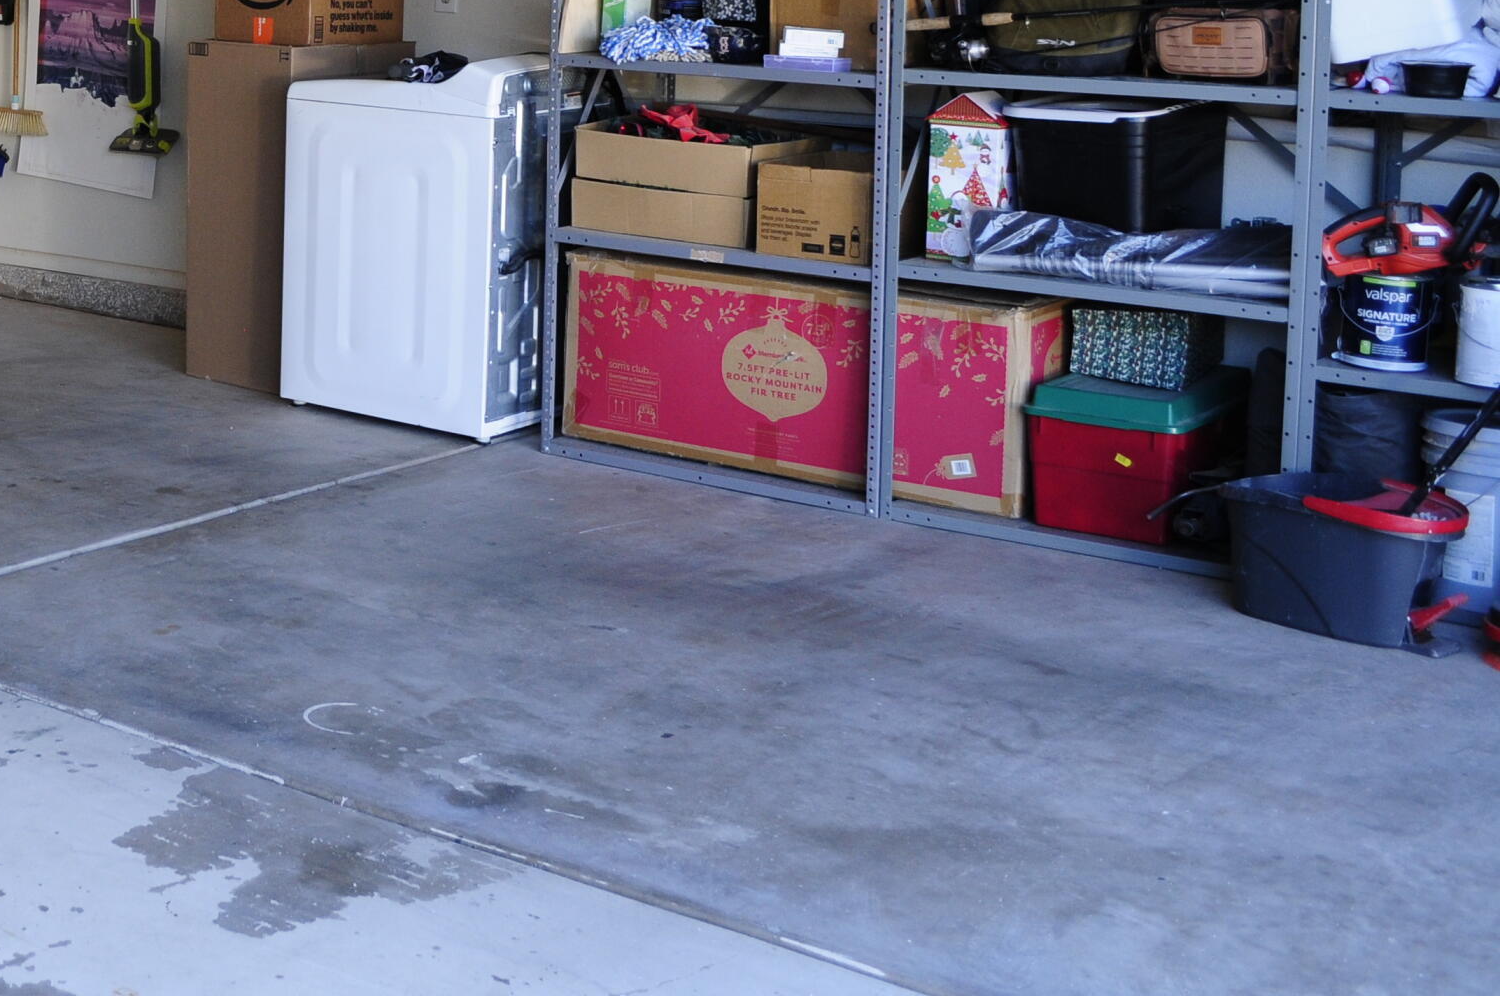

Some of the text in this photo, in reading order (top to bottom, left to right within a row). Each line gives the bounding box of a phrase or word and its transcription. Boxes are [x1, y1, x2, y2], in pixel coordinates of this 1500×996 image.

[342, 0, 354, 11] you
[1364, 287, 1413, 305] valspar
[1356, 307, 1417, 323] SIGNATURE
[737, 363, 811, 381] 7.5FT PRE-LIT
[726, 372, 823, 394] ROCKY MOUNTAIN
[750, 387, 797, 402] FIR TREE
